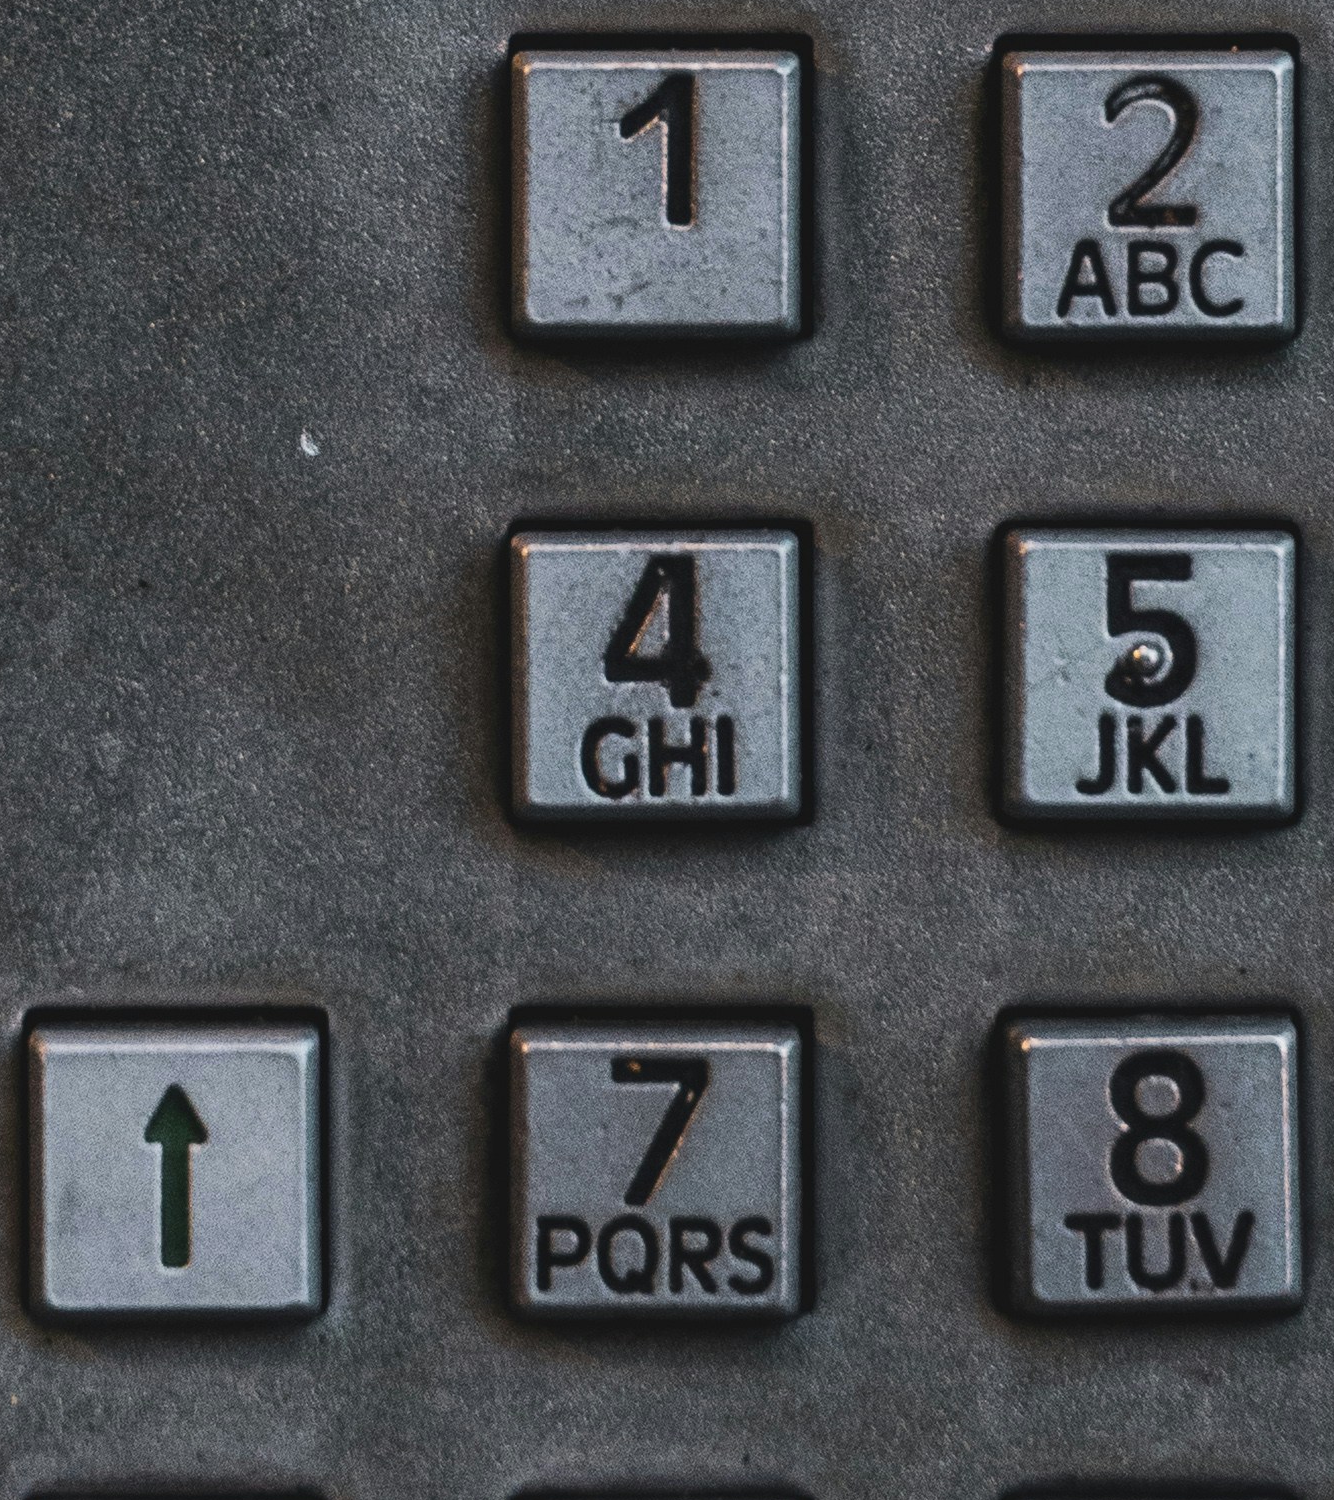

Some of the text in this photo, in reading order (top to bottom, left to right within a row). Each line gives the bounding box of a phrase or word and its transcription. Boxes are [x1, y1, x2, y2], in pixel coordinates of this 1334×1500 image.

[618, 71, 698, 230] 1
[1102, 72, 1201, 230] 2
[1054, 237, 1248, 320] ABC
[603, 550, 712, 710] 4
[1103, 551, 1198, 708] 5
[578, 715, 739, 799] GHI
[1074, 713, 1232, 799] JKL
[609, 1054, 711, 1207] 7
[1105, 1048, 1210, 1207] 8
[533, 1213, 777, 1297] PQRS
[1064, 1211, 1256, 1294] TUV
